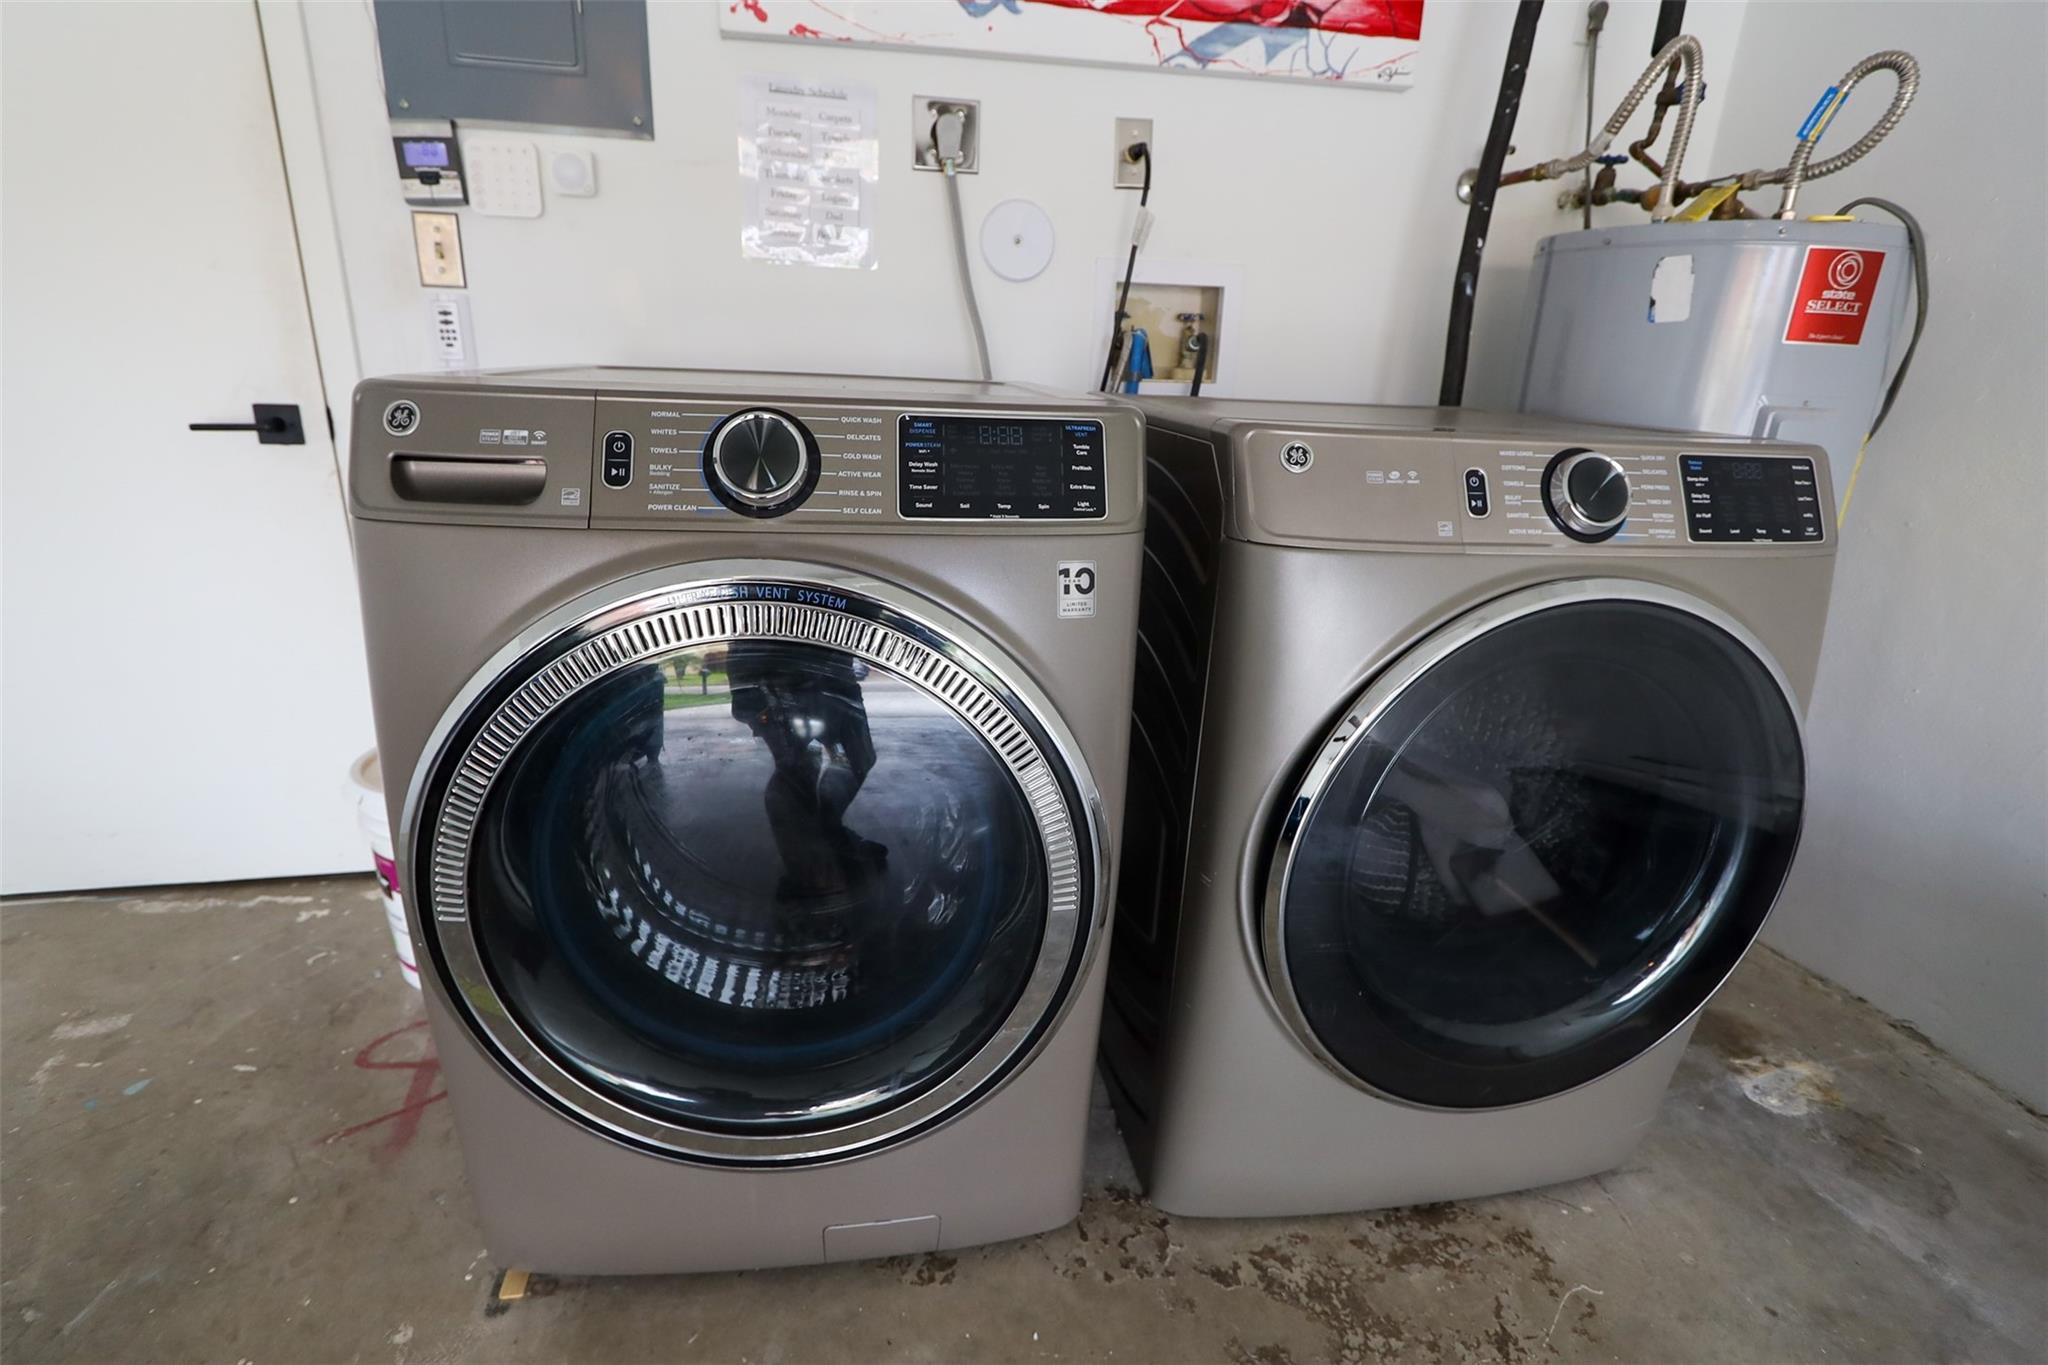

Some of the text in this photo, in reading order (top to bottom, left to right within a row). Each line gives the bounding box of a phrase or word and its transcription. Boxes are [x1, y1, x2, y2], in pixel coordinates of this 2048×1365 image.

[1822, 290, 1856, 300] state
[1806, 300, 1863, 312] SELECT
[841, 416, 861, 424] QUICK
[650, 447, 678, 455] TOWELS
[1059, 567, 1095, 595] 10
[756, 587, 790, 599] VENT
[798, 590, 847, 609] SYSTEM
